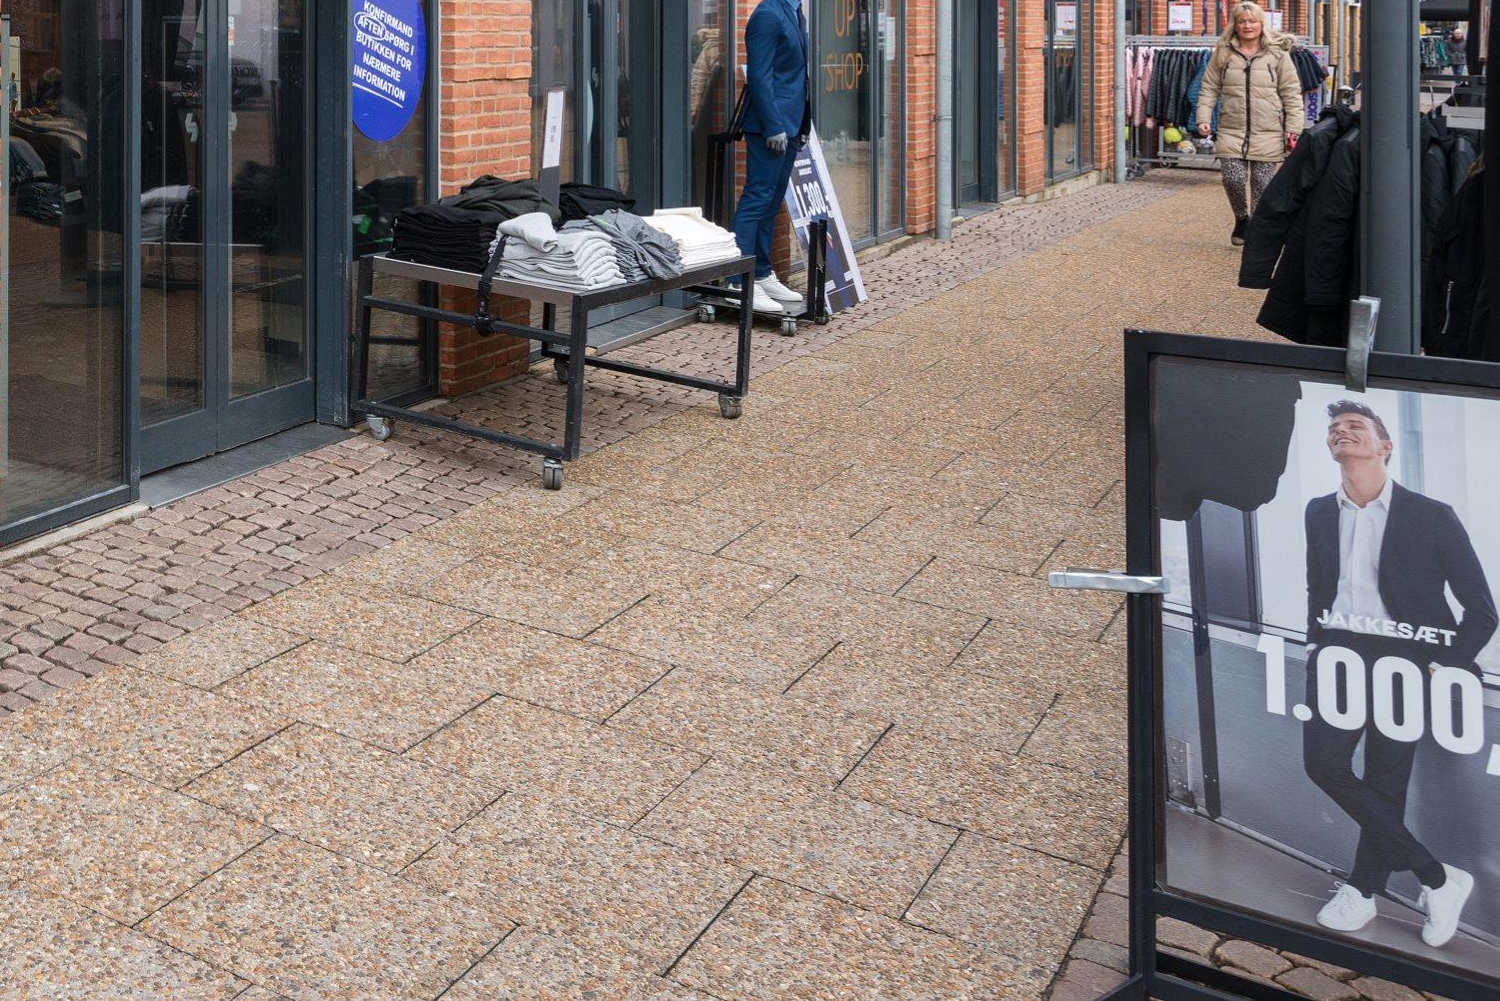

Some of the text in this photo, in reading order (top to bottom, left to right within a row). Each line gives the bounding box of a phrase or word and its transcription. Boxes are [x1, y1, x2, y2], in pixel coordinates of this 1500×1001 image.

[358, 15, 384, 39] AFTEN
[384, 30, 410, 52] SPØRG
[363, 0, 413, 38] KONFIRMAND
[356, 32, 412, 72] BUTIKKEN FOR
[363, 52, 401, 82] NÆRMERE
[353, 64, 406, 101] INFORMATION
[826, 51, 864, 92] SHOP
[1316, 609, 1457, 647] JAKKESÆT
